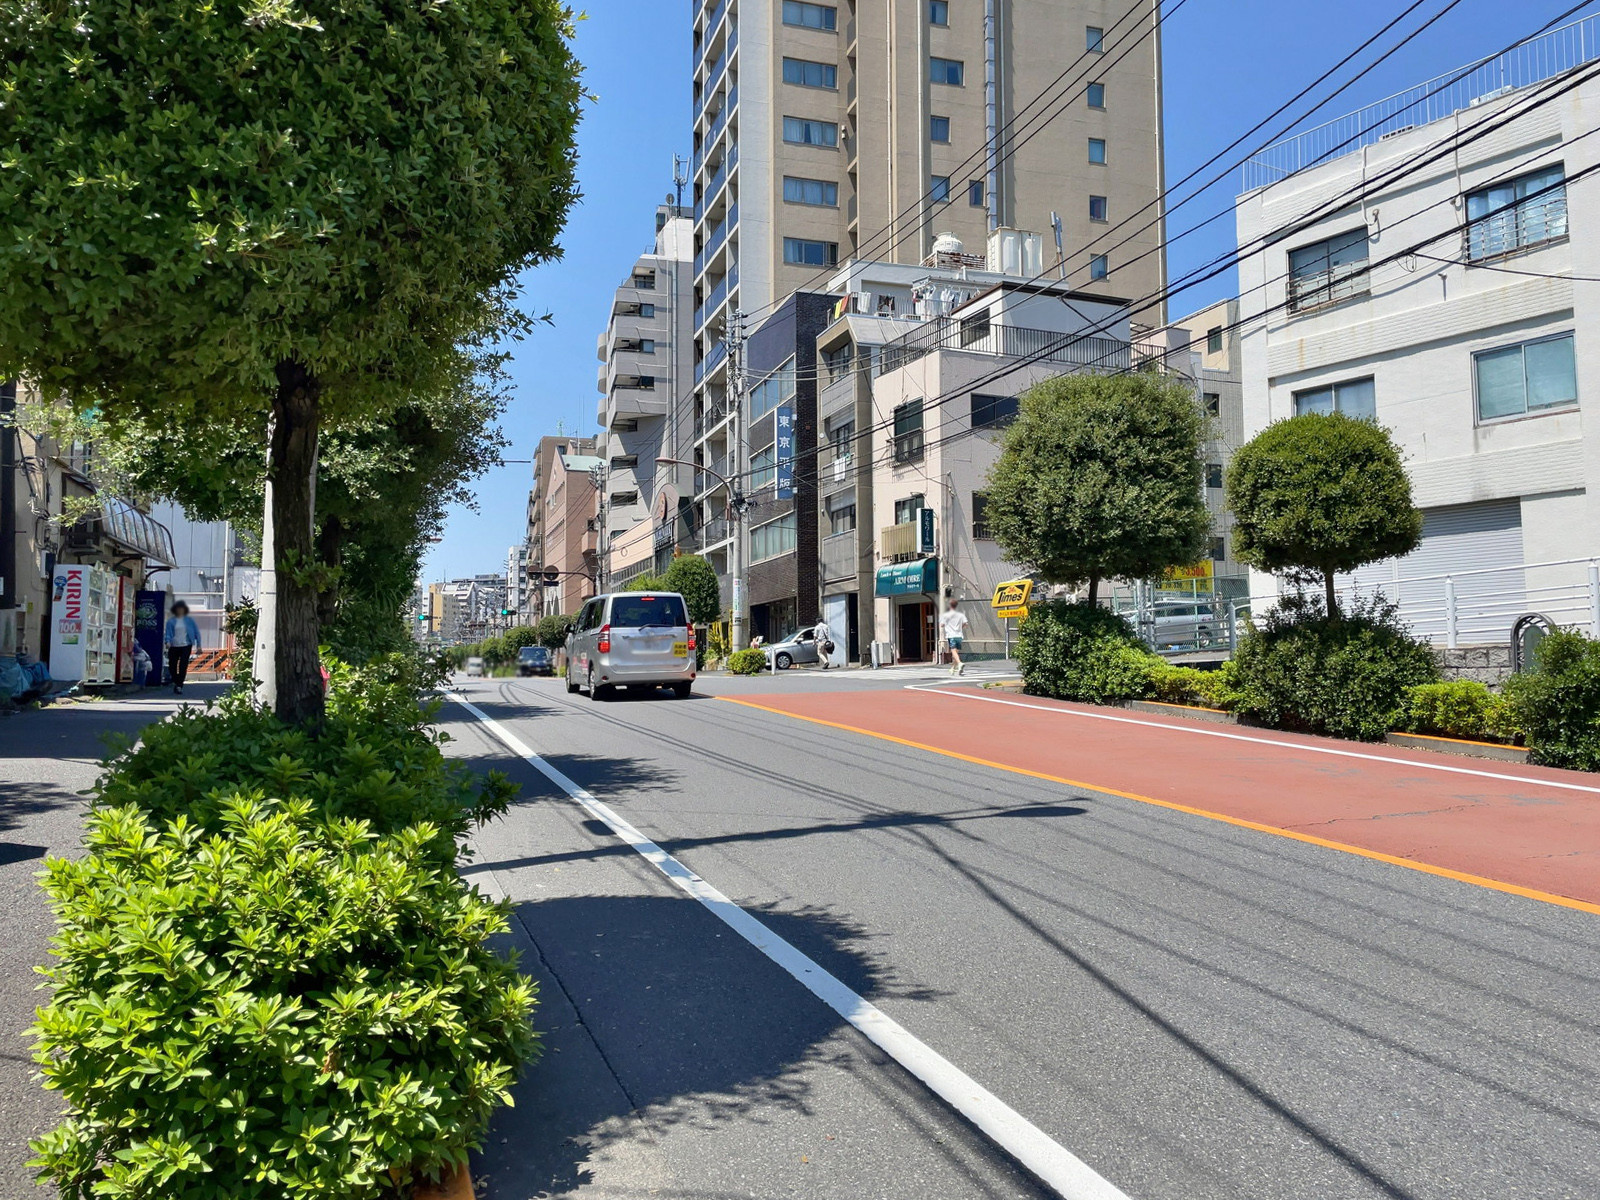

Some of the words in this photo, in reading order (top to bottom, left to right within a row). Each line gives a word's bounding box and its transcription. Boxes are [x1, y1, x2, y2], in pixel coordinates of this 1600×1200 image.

[778, 415, 790, 490] 東京平版
[66, 570, 82, 619] KIRIN
[997, 589, 1023, 604] Times
[136, 618, 158, 627] BOSS
